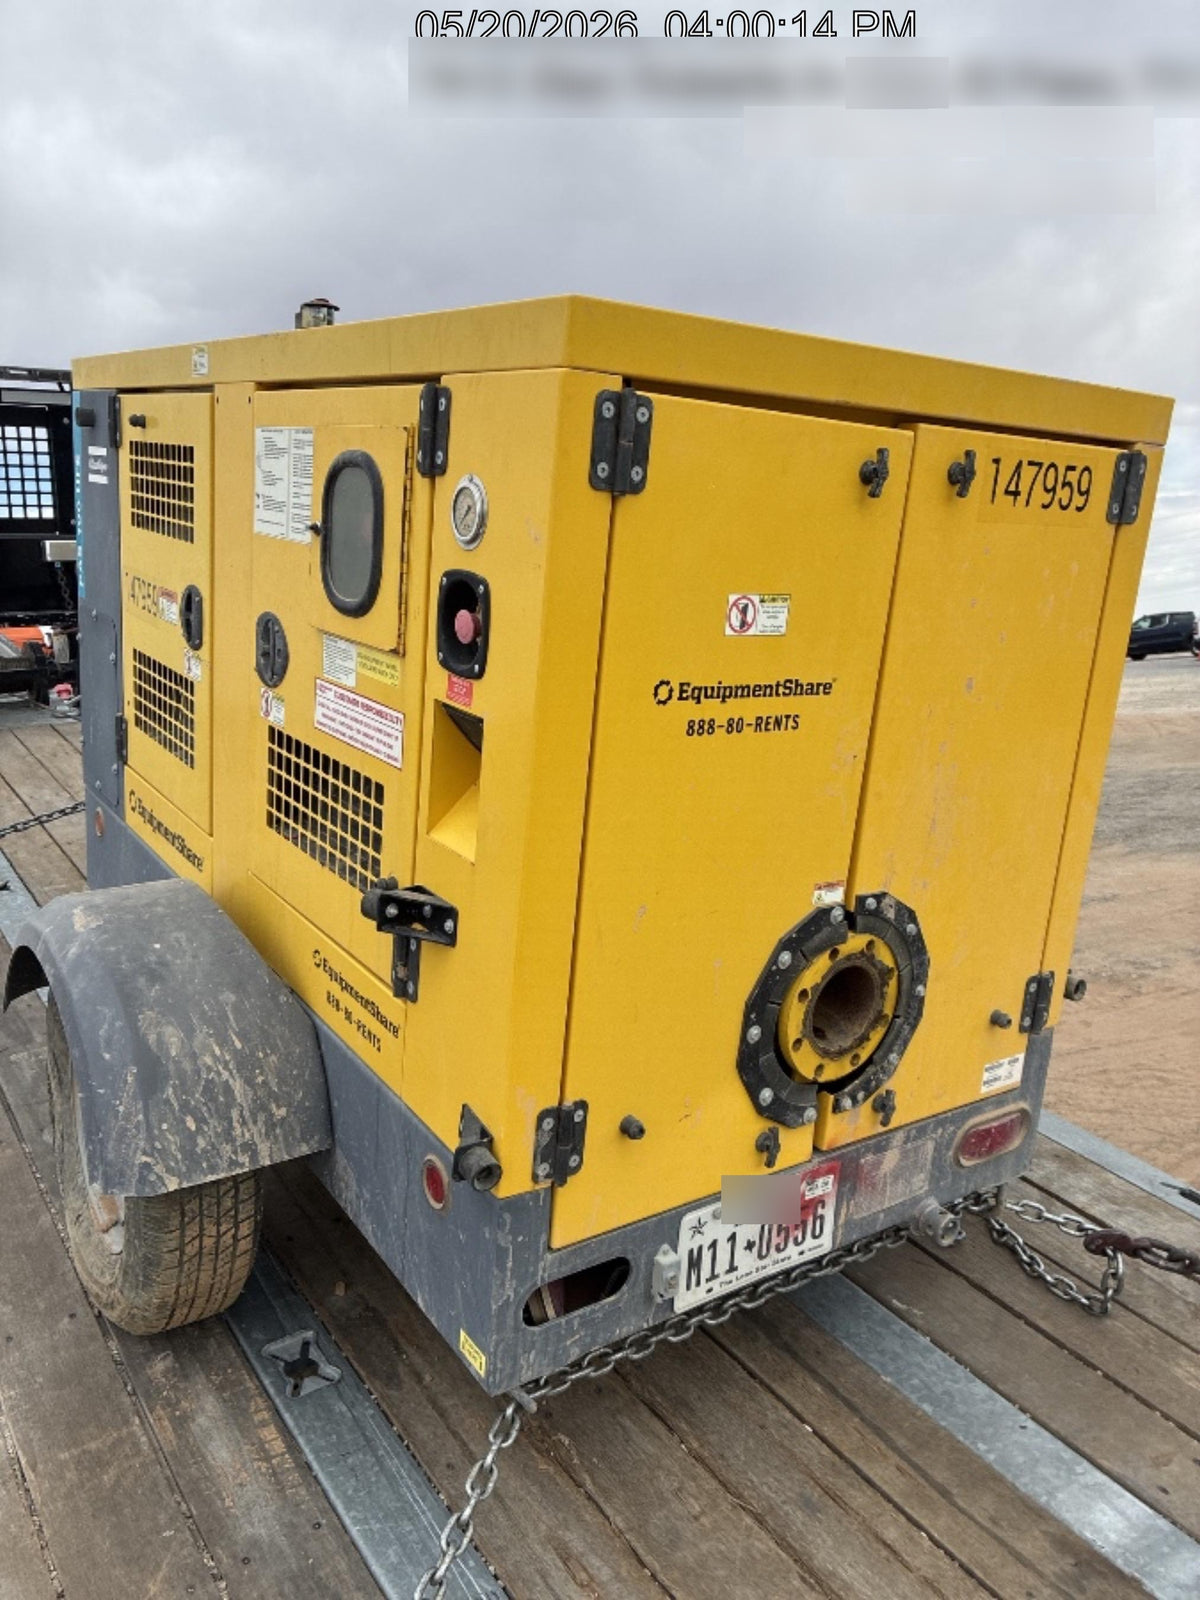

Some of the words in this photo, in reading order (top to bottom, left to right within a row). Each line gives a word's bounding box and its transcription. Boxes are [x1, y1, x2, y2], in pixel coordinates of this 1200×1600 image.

[991, 457, 1093, 512] 147959
[677, 679, 833, 705] EquipmentShare
[686, 714, 800, 737] 888-80-RENTS
[323, 957, 399, 1039] EquipmentShare
